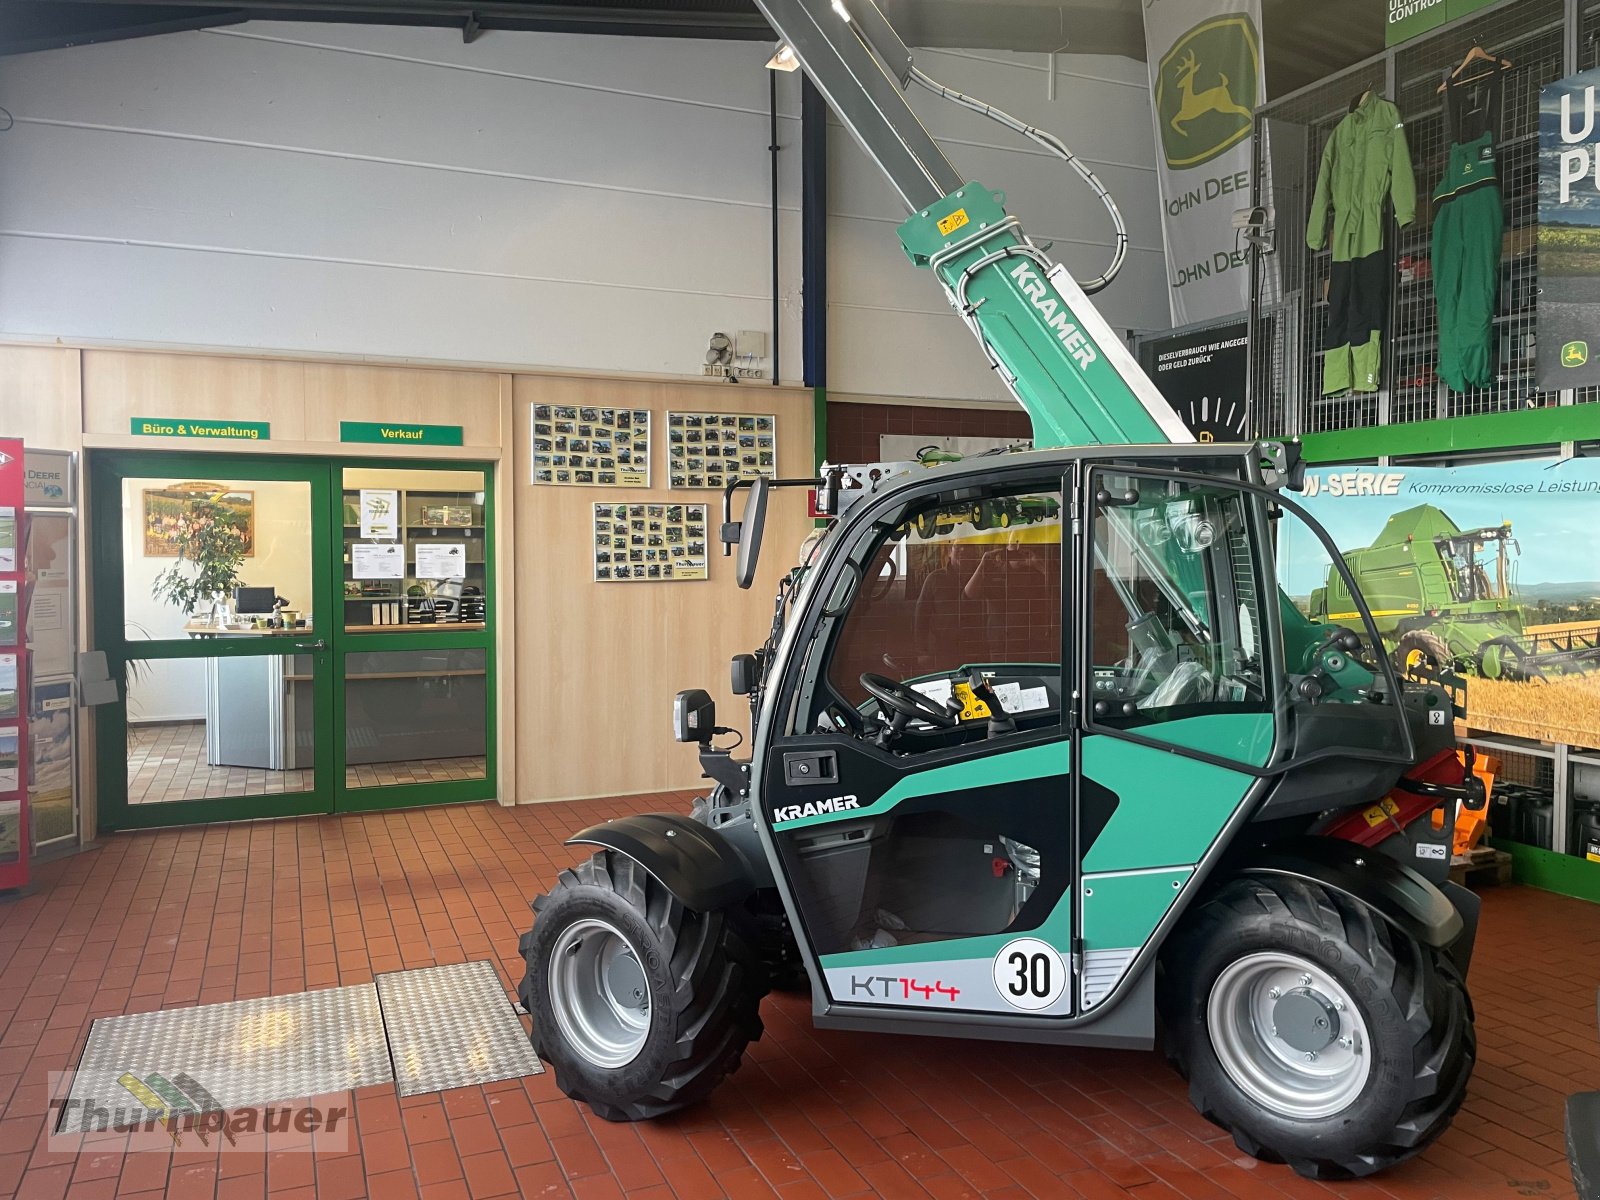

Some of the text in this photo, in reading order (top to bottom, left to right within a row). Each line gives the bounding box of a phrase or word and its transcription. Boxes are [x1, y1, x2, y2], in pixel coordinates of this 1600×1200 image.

[1389, 0, 1441, 24] CONTRO
[1204, 170, 1250, 201] DEE
[1560, 142, 1600, 204] P
[1010, 261, 1097, 371] KRAMER
[1158, 345, 1207, 361] DIESELVERBRAUCH
[1208, 342, 1220, 351] WIE
[1158, 360, 1173, 372] ODER
[1173, 358, 1188, 368] GELD
[143, 423, 258, 439] Büro & Verwaltung
[380, 428, 424, 439] Verkauf
[27, 469, 62, 480] DEERE
[1300, 472, 1405, 498] W-SERIE
[1408, 480, 1535, 495] Kompromisslose
[773, 794, 861, 823] KRAMER
[1008, 951, 1051, 998] 30
[851, 974, 961, 1002] KT144
